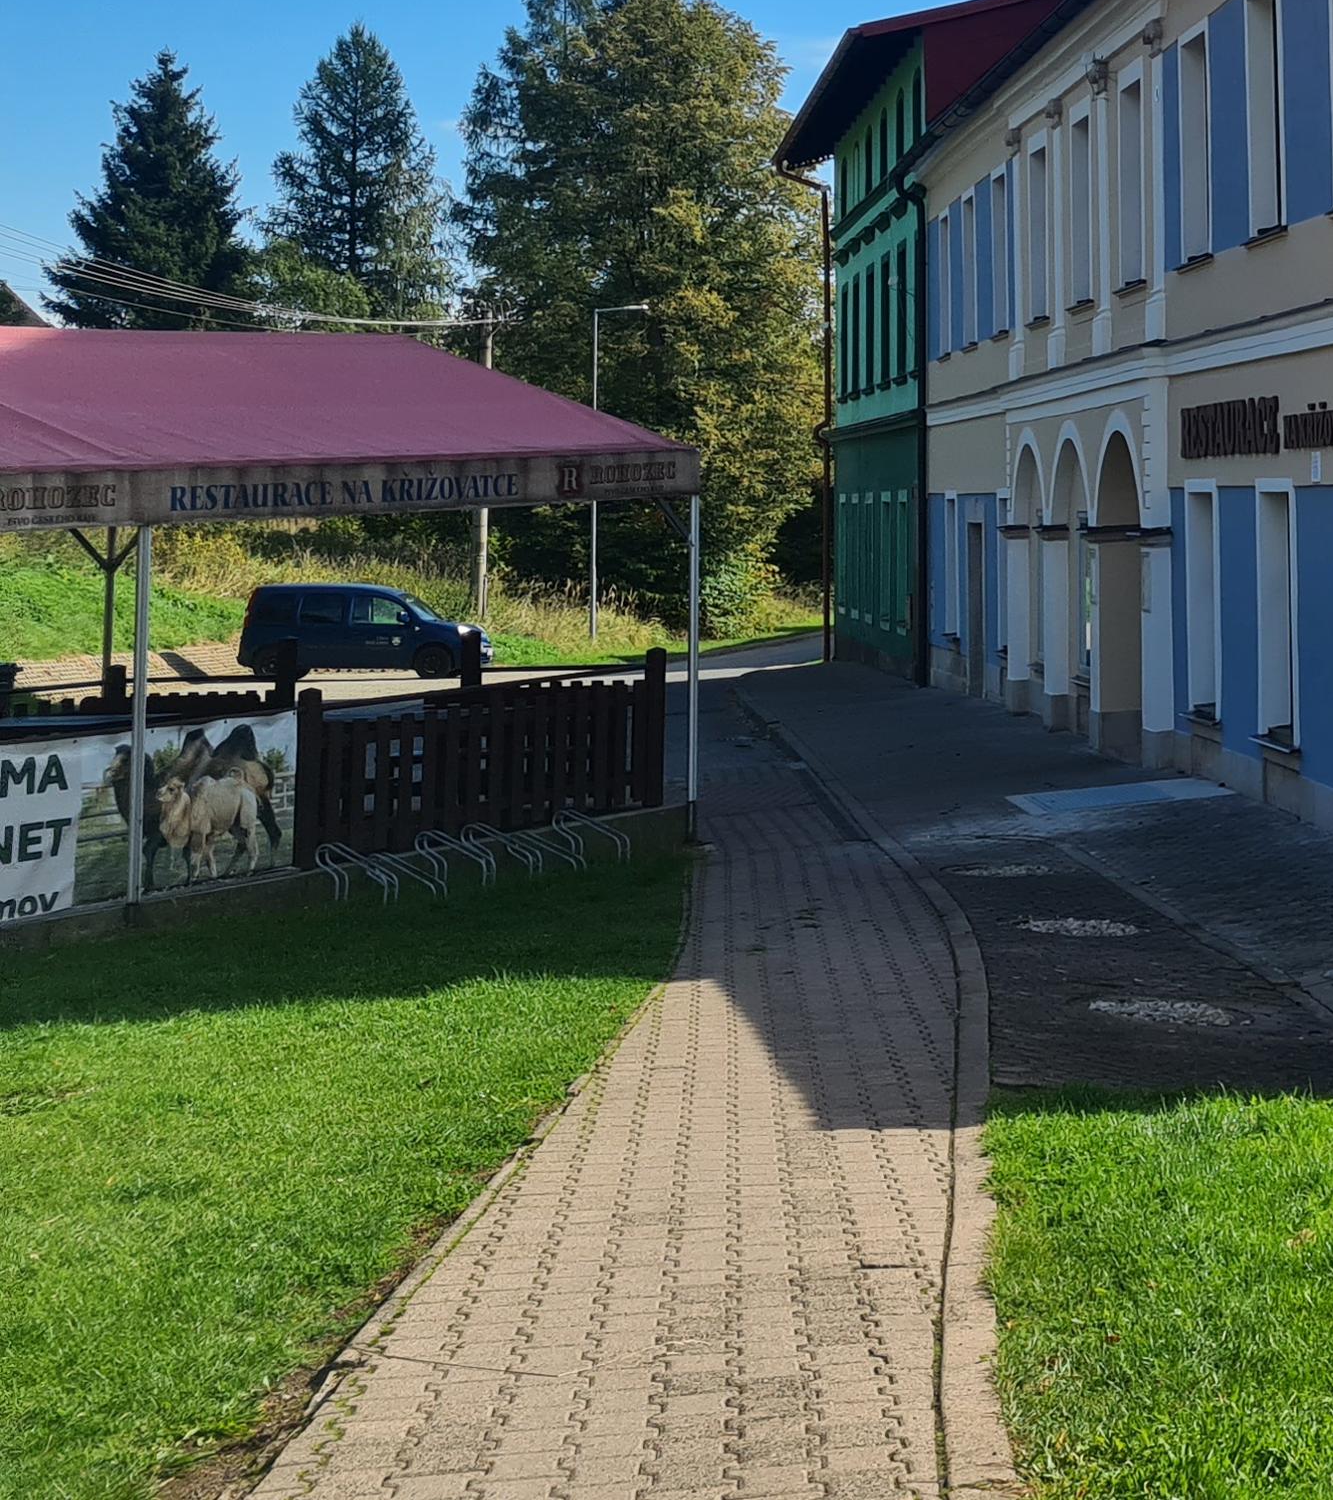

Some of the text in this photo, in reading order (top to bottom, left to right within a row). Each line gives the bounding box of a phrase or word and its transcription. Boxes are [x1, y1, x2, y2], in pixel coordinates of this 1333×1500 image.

[1181, 395, 1280, 460] RESTAURACE
[1283, 414, 1298, 450] NA
[170, 471, 520, 512] RESTAURACE NA KŘIŽOVATCE
[590, 461, 676, 484] ROHOZEC
